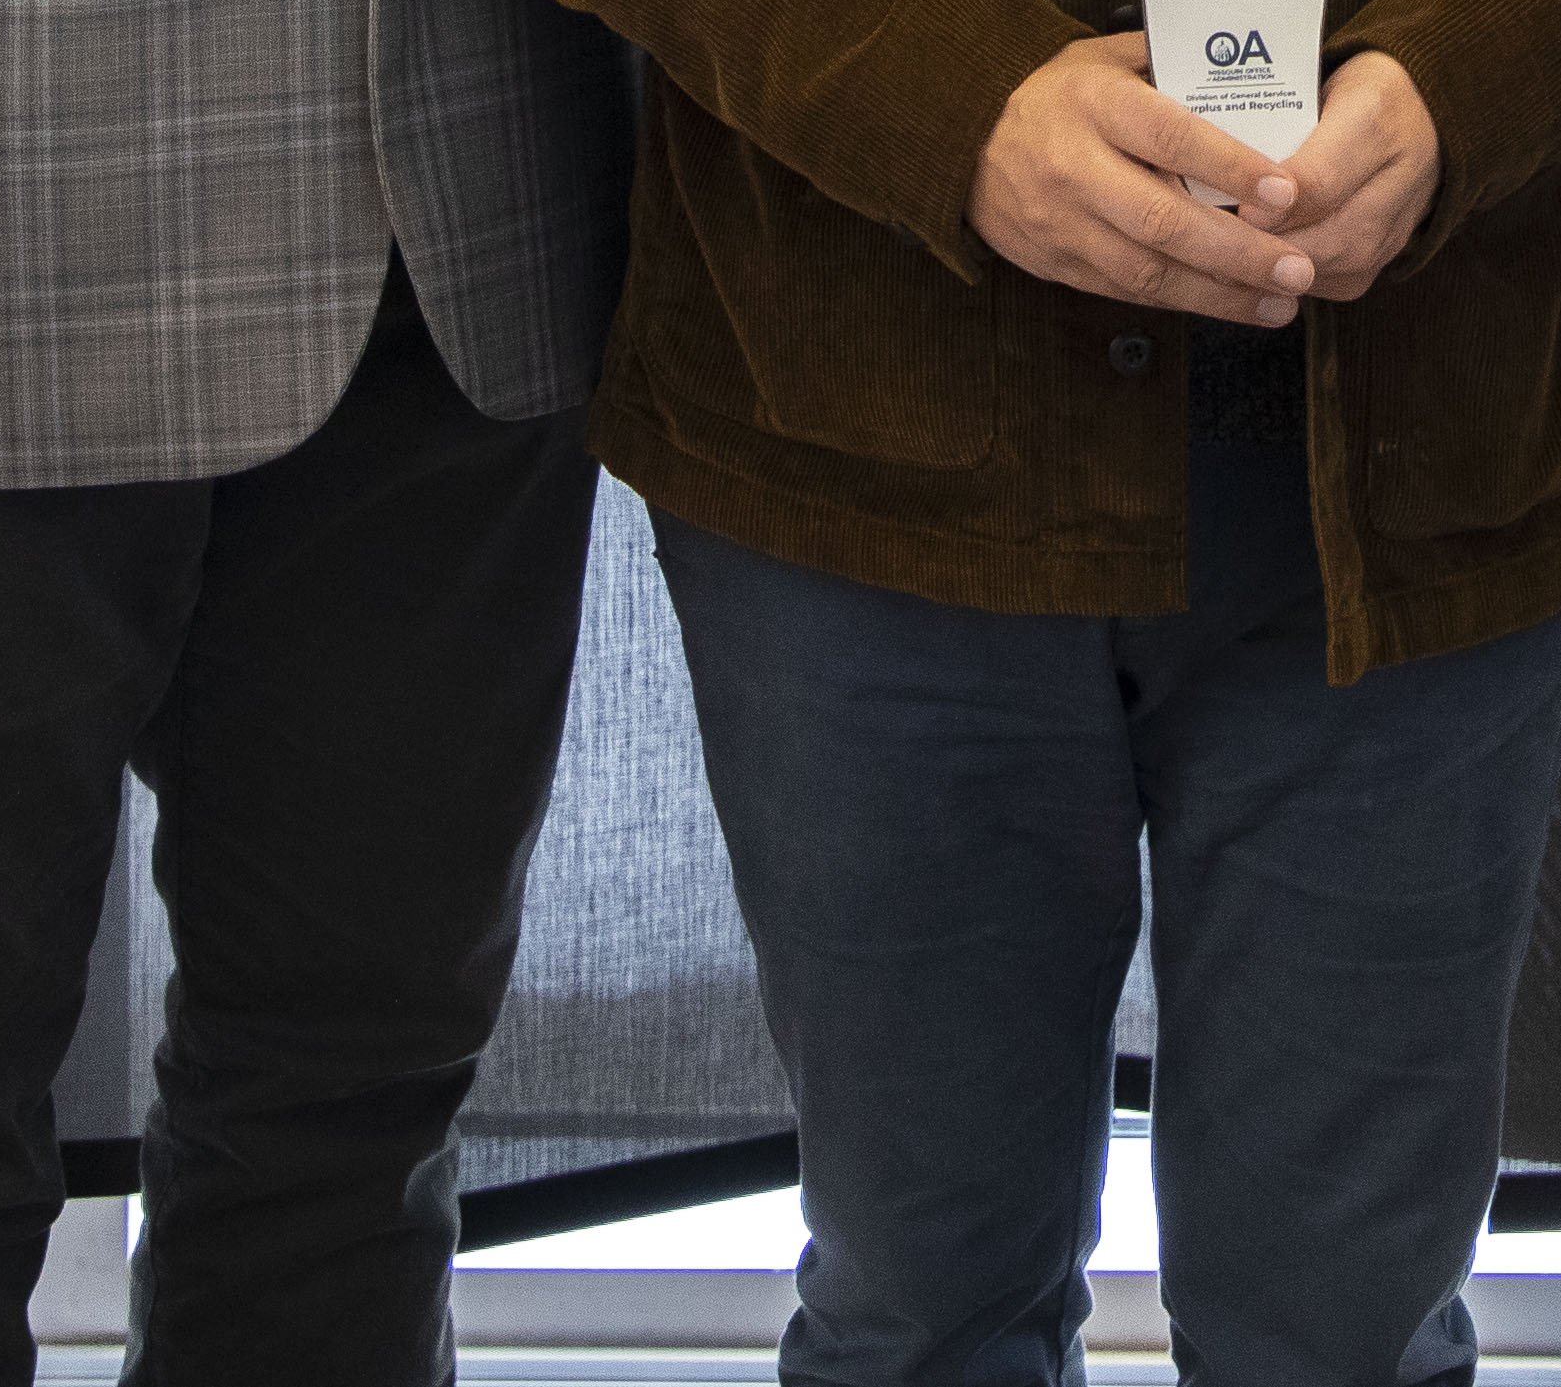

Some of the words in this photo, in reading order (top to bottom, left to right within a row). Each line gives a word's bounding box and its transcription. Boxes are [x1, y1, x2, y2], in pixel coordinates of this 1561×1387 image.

[1205, 29, 1273, 67] OA
[1186, 93, 1218, 101] Division
[1230, 91, 1261, 99] General
[1263, 89, 1297, 97] Services
[1183, 102, 1222, 114] urplus
[1225, 101, 1246, 111] and
[1249, 99, 1303, 111] Recycling
